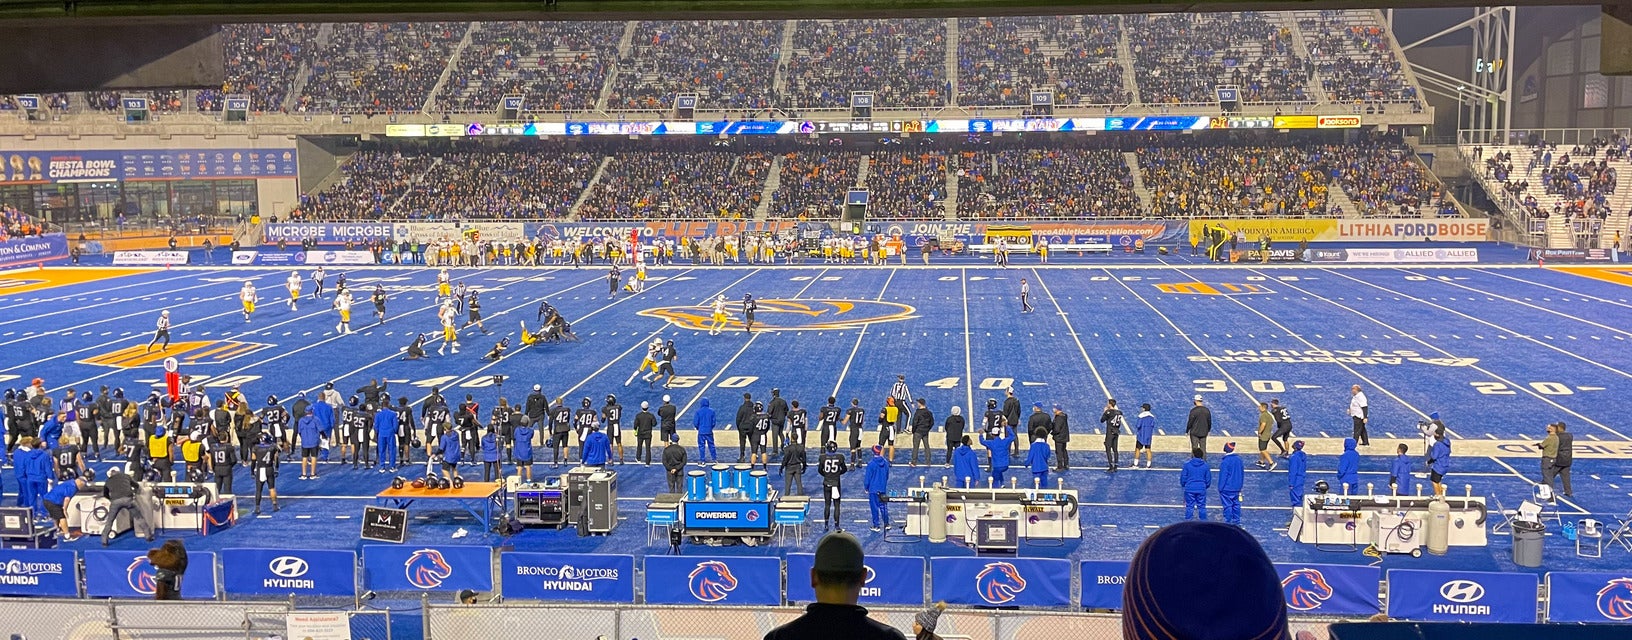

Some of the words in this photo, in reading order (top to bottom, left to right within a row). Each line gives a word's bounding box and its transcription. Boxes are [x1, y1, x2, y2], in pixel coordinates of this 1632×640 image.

[49, 160, 84, 170] FIESTA
[86, 160, 116, 169] BOWL
[49, 169, 110, 178] CHAMPIONS
[268, 226, 326, 237] MICROBE
[332, 226, 391, 237] MICROBE
[563, 226, 632, 237] WELCOME
[910, 224, 942, 233] JOIN
[945, 224, 971, 233] THE
[1032, 227, 1153, 236] oncoAthleticAssociation.com
[80, 407, 89, 419] 91
[266, 410, 280, 422] 23
[431, 410, 446, 422] 34
[555, 411, 569, 424] 42
[579, 413, 593, 425] 48
[609, 409, 619, 421] 31
[826, 411, 837, 422] 21
[855, 411, 864, 424] 17
[353, 416, 366, 428] 25
[755, 418, 768, 430] 46
[793, 414, 805, 426] 24
[60, 452, 72, 466] 81
[214, 450, 226, 463] 19
[262, 451, 271, 464] 4
[824, 459, 839, 473] 65
[695, 511, 737, 519] POWERADE
[22, 562, 62, 574] MOTORS
[517, 566, 558, 577] BRONCO
[576, 567, 618, 580] MOTORS
[0, 575, 39, 585] YUNDAI
[263, 578, 314, 589] HYUNDAI
[543, 580, 592, 591] HYUNDAI
[1097, 575, 1126, 585] BRON
[1433, 604, 1490, 616] HYUNDAI
